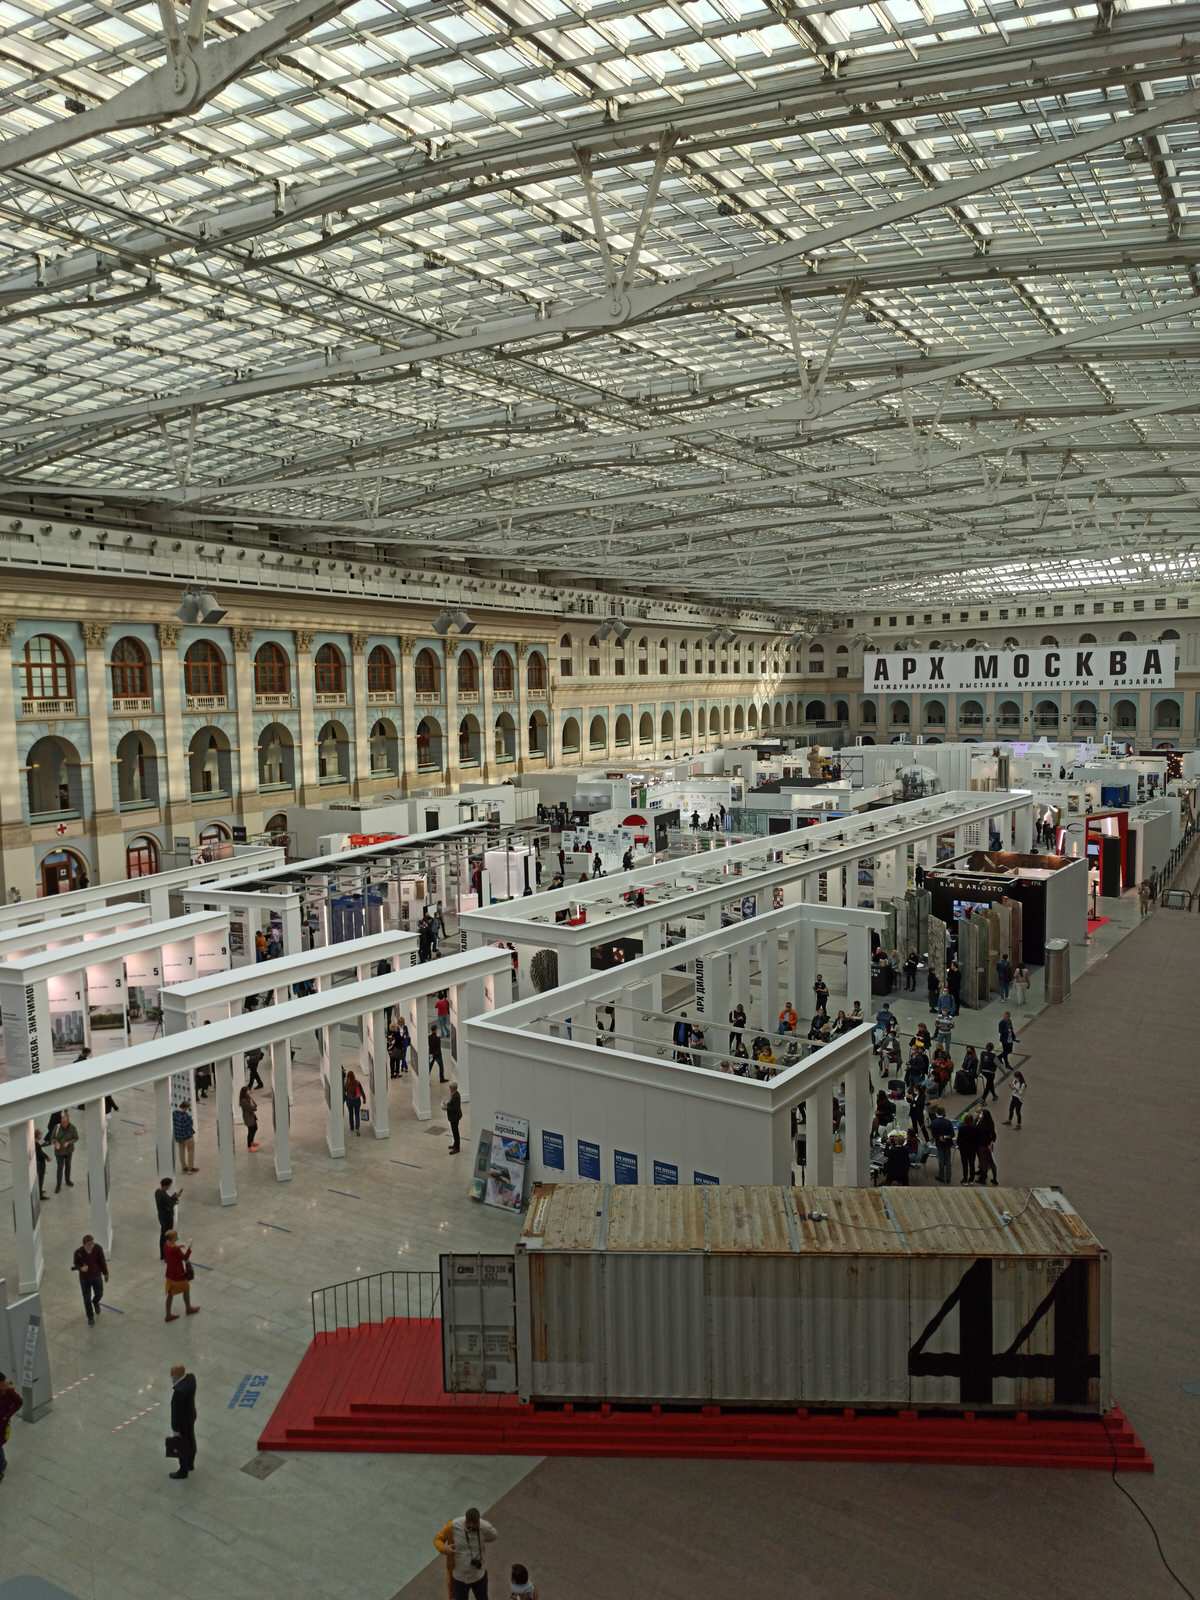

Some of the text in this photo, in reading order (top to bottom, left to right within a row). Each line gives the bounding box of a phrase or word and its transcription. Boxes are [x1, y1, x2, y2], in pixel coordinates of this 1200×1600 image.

[873, 648, 1162, 681] АРХ МОСКВА
[1018, 679, 1089, 687] АРХИТЕКТУРЫ
[1114, 677, 1163, 687] ДИЗАЙНА
[221, 947, 227, 956] 9
[188, 956, 193, 966] 7
[153, 968, 159, 976] 5
[115, 979, 121, 988] 3
[695, 958, 705, 1013] АРХ ДИАЛОГ
[75, 991, 81, 1000] 1
[907, 1257, 1101, 1405] 44
